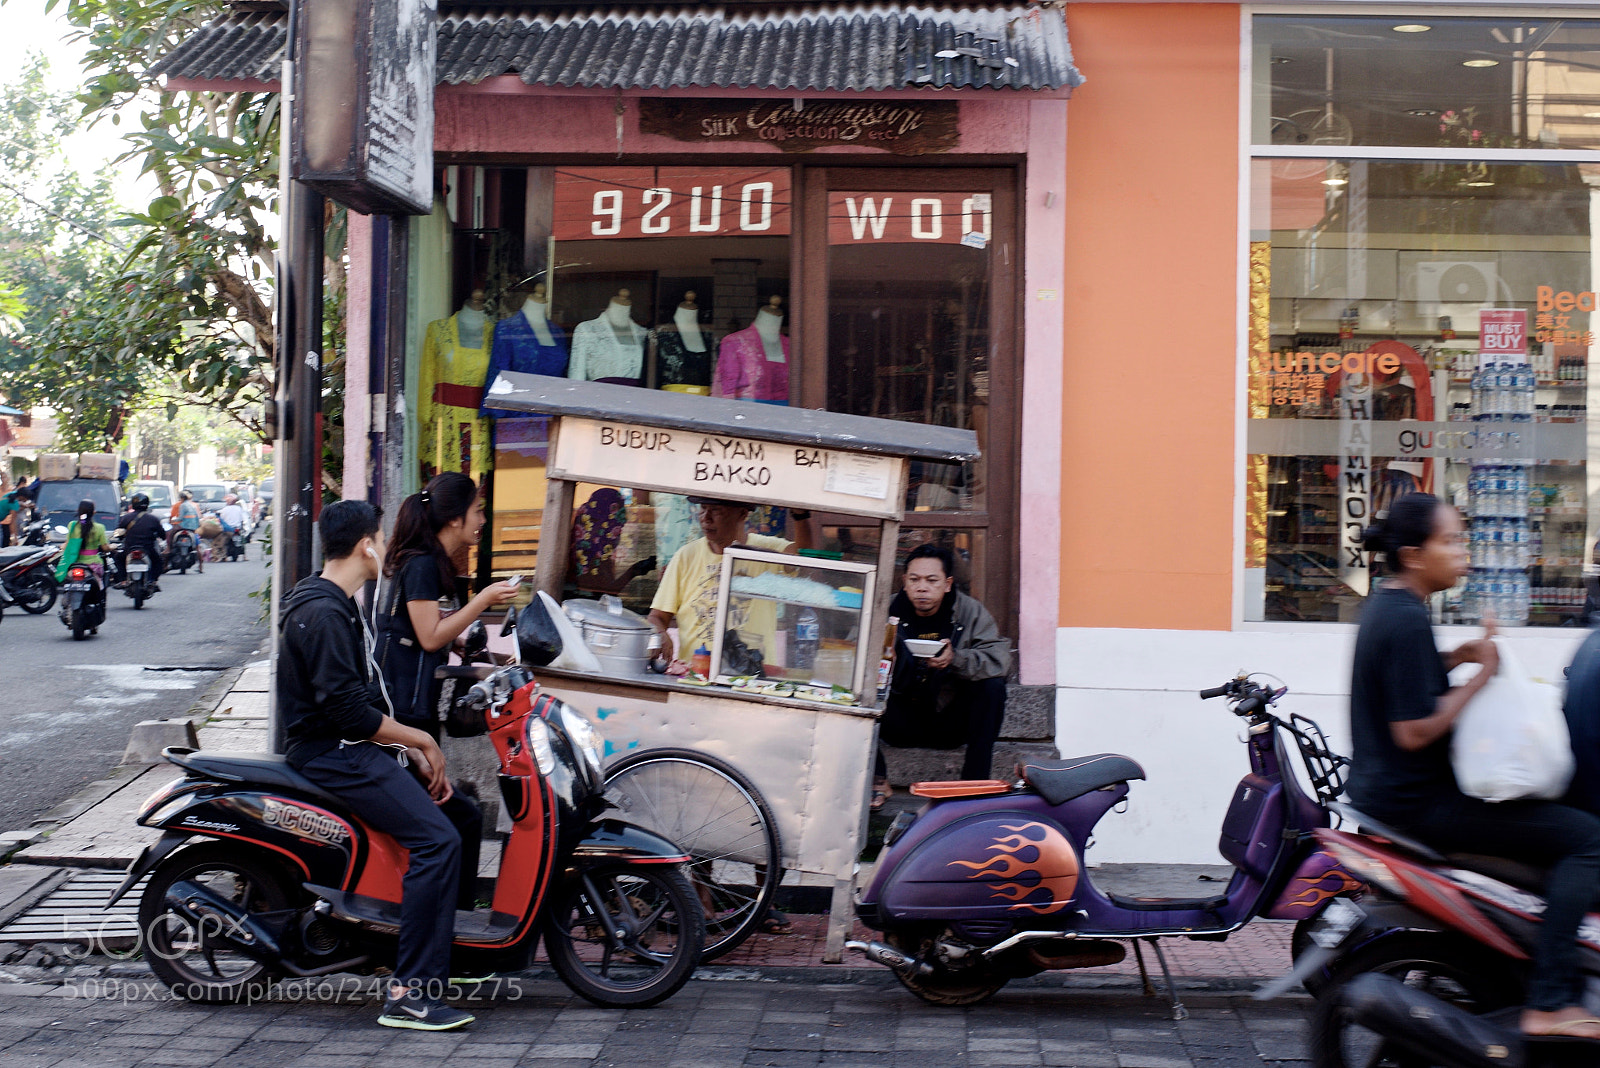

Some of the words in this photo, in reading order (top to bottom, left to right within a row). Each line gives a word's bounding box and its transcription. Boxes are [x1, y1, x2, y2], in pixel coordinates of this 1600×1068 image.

[1536, 285, 1600, 313] Bea
[1484, 323, 1523, 335] MUST
[1535, 313, 1572, 330] 美女
[1484, 335, 1522, 349] BUY
[1257, 352, 1401, 374] suncare
[600, 426, 675, 452] BUBUR
[698, 438, 765, 461] AYAM
[1399, 425, 1521, 453] guardian
[695, 463, 771, 486] BAKSO
